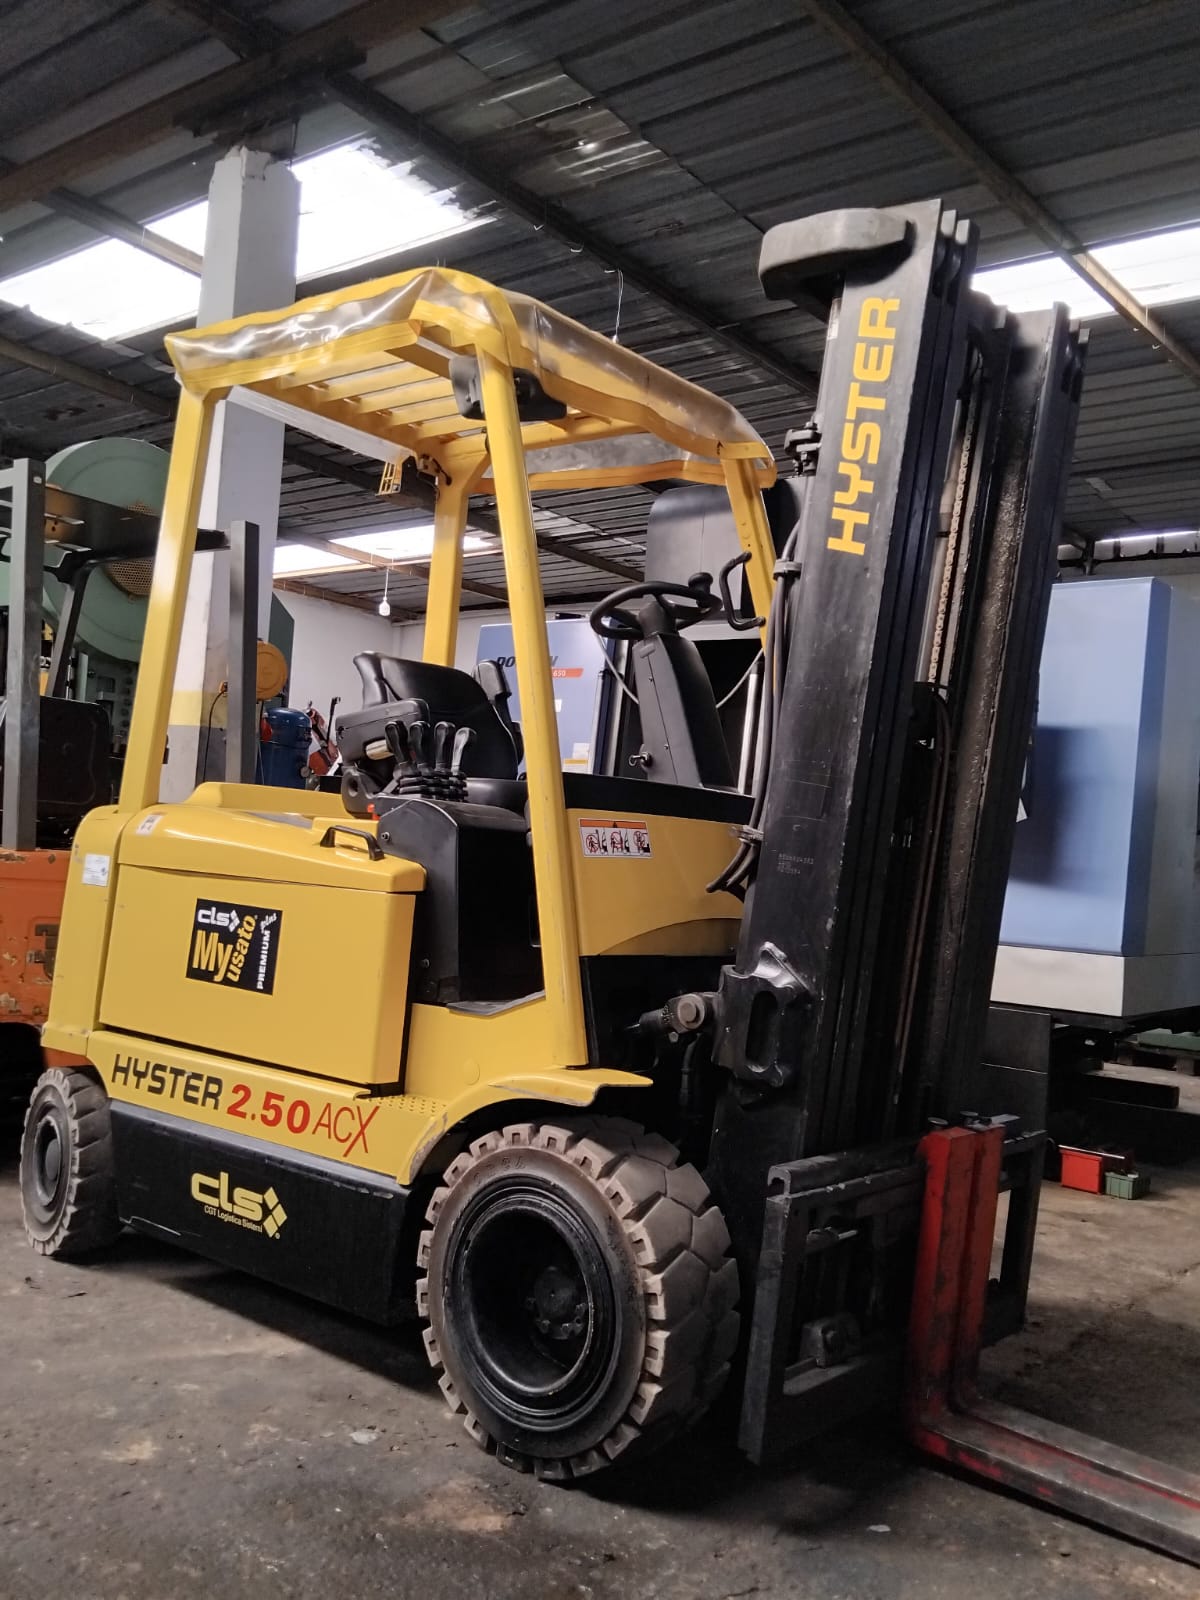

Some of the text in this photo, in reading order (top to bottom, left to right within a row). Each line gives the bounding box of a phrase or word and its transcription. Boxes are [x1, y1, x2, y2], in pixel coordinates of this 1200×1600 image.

[827, 297, 900, 556] HYSTER
[198, 906, 230, 927] cls
[192, 930, 233, 982] My
[226, 915, 256, 982] usato
[257, 930, 271, 990] PREMIUM
[111, 1054, 223, 1110] HYSTER
[191, 1171, 263, 1221] cls
[204, 1205, 217, 1217] CGT
